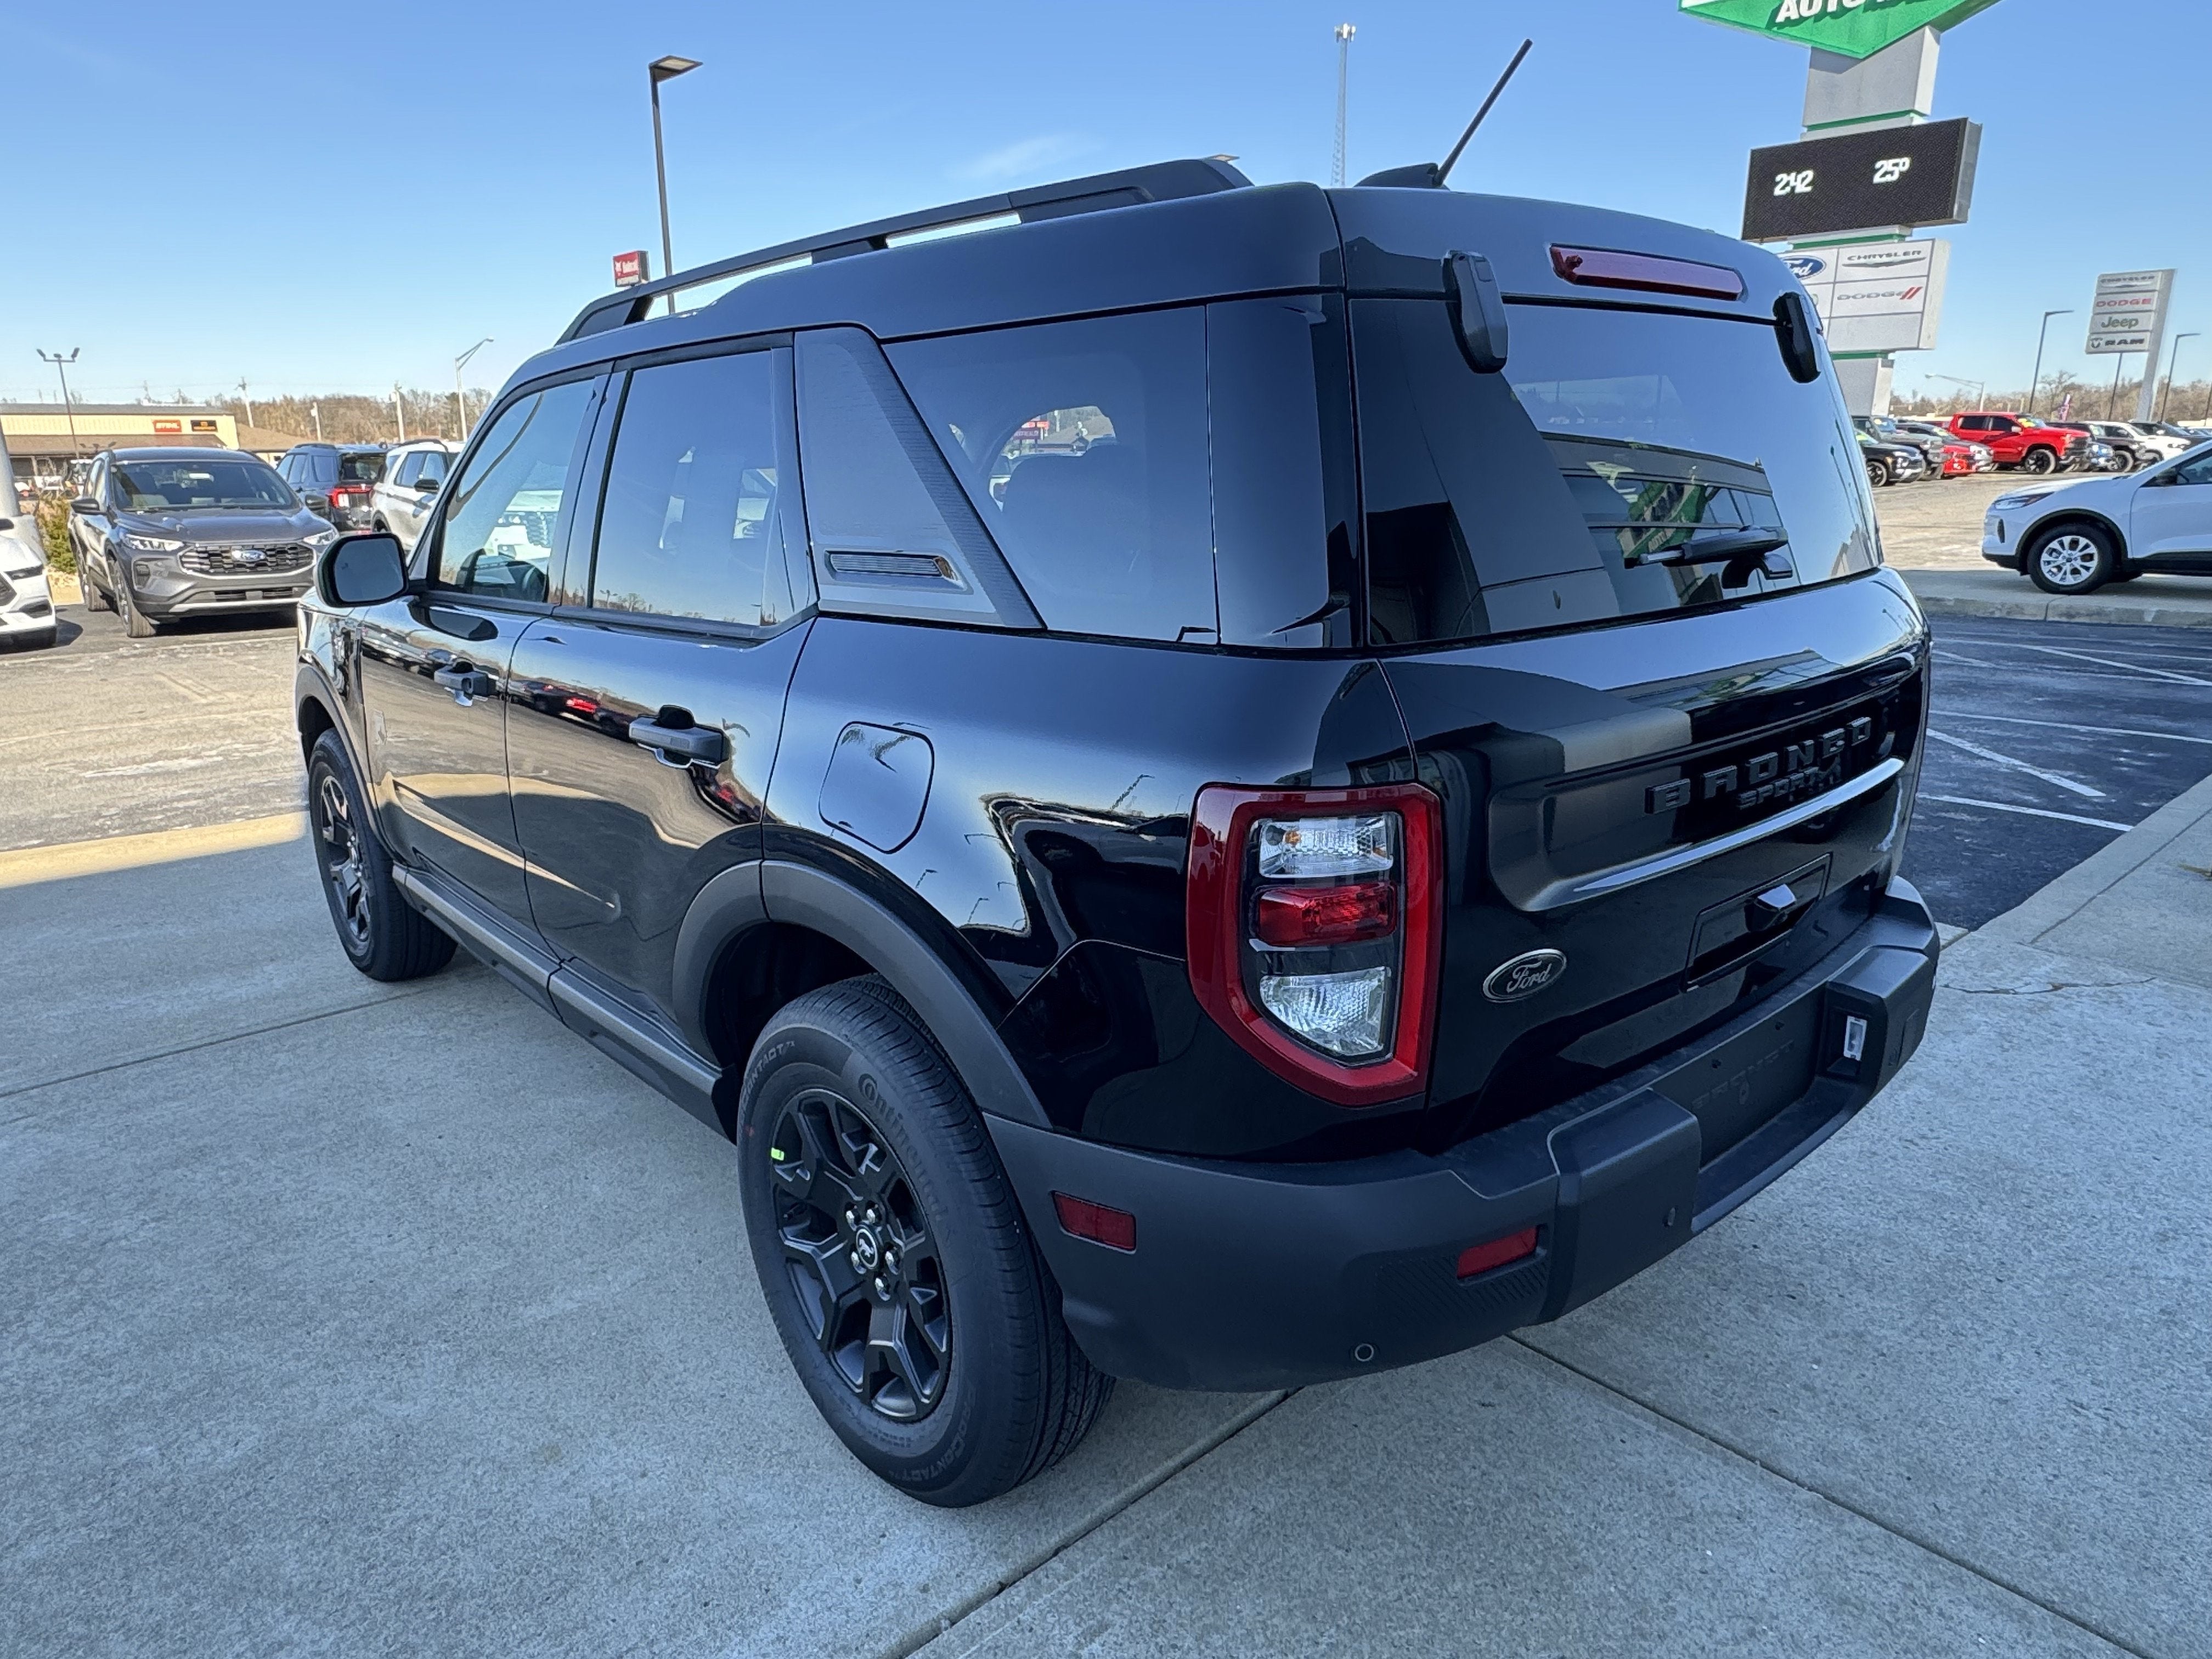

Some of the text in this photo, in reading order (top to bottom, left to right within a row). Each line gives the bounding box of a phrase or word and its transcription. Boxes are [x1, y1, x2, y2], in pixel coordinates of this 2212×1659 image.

[1847, 250, 1922, 261] CHRYSLER
[2096, 298, 2152, 307] DODGE
[2101, 316, 2139, 329] Jeep
[2104, 338, 2145, 346] RAM
[1647, 716, 1872, 814] BRONCO
[1738, 766, 1820, 810] SPORT
[1506, 961, 1553, 993] Ford
